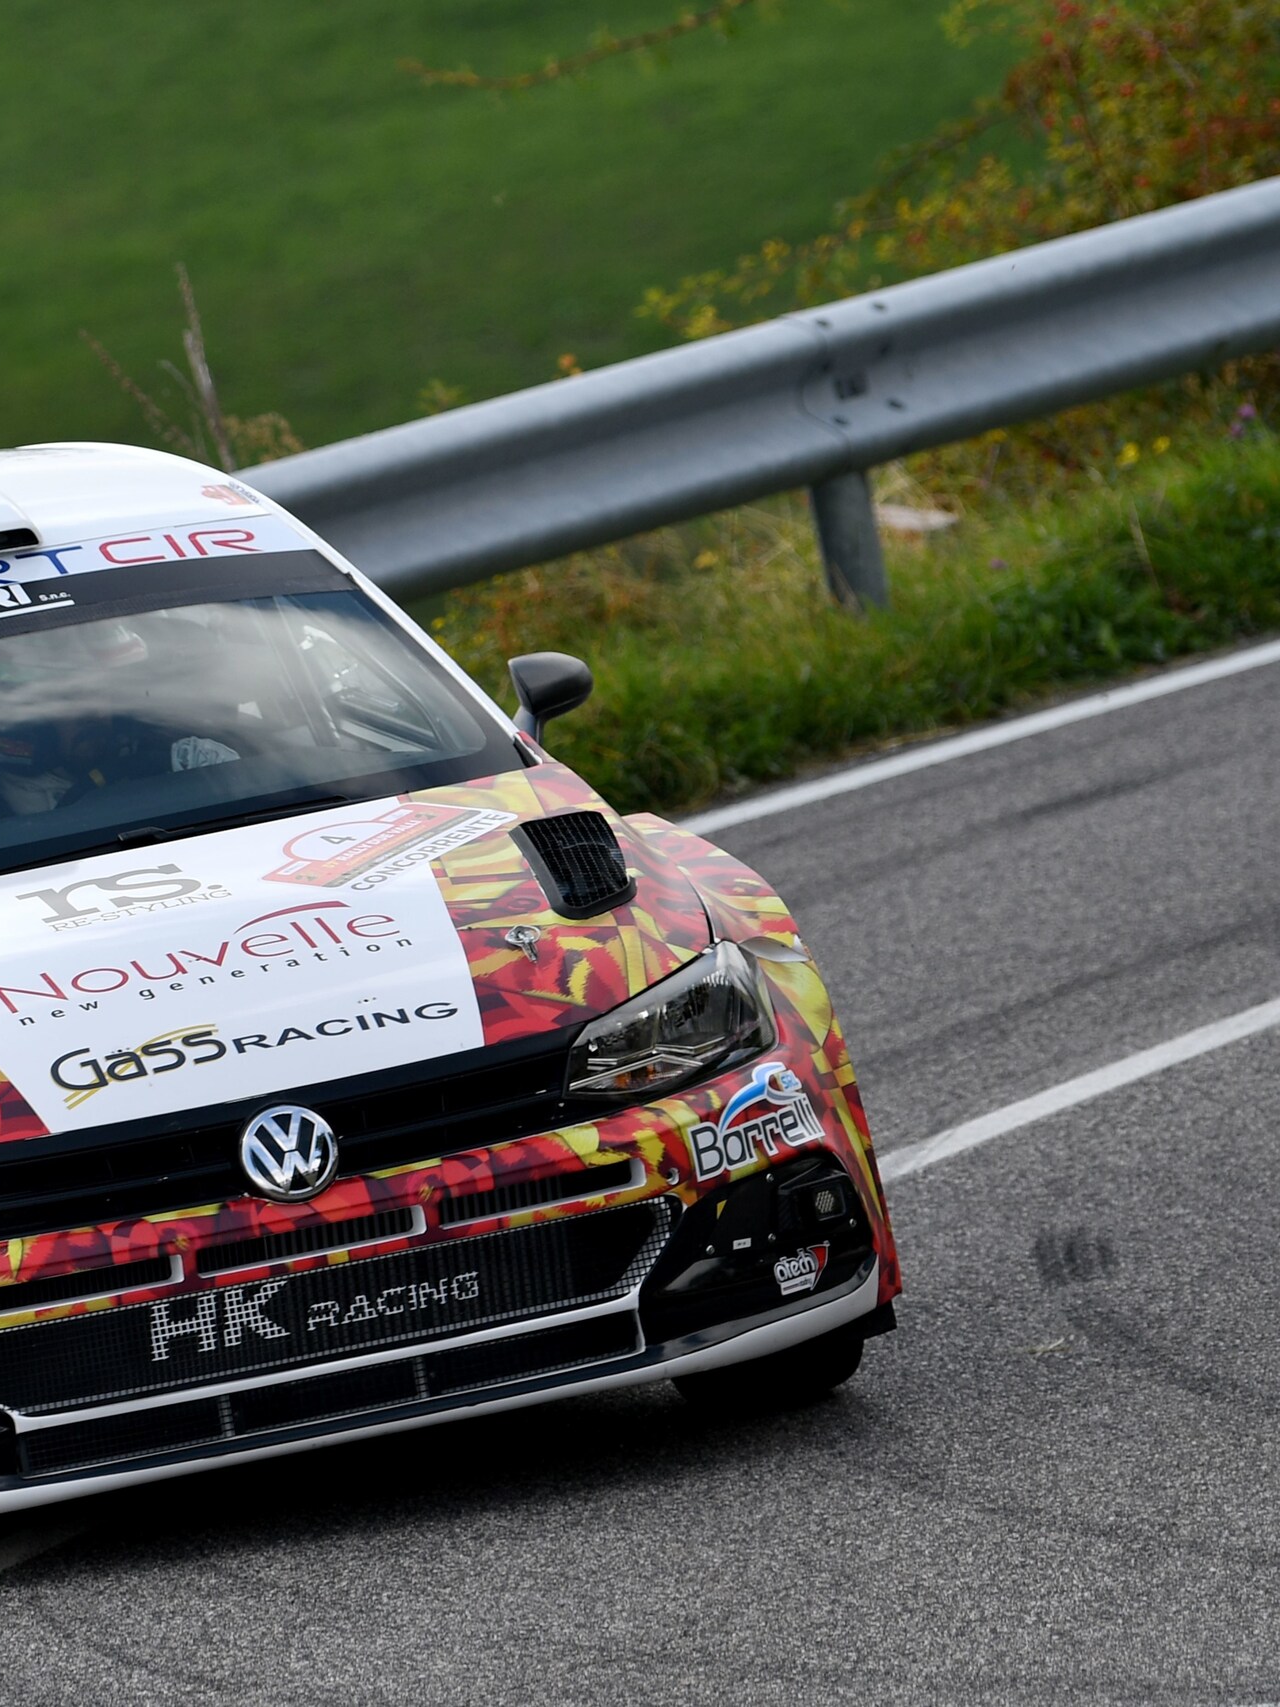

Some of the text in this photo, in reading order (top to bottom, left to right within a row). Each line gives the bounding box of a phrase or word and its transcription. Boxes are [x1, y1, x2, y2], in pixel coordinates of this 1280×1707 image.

[319, 835, 357, 845] 4
[350, 813, 508, 892] CONCORRENTE
[48, 888, 233, 933] RE-STYLING
[18, 937, 414, 1028] new generation
[232, 1002, 459, 1054] RACING
[690, 1097, 823, 1178] Borrelli
[776, 1250, 816, 1283] atech
[150, 1271, 479, 1363] HK RACING
